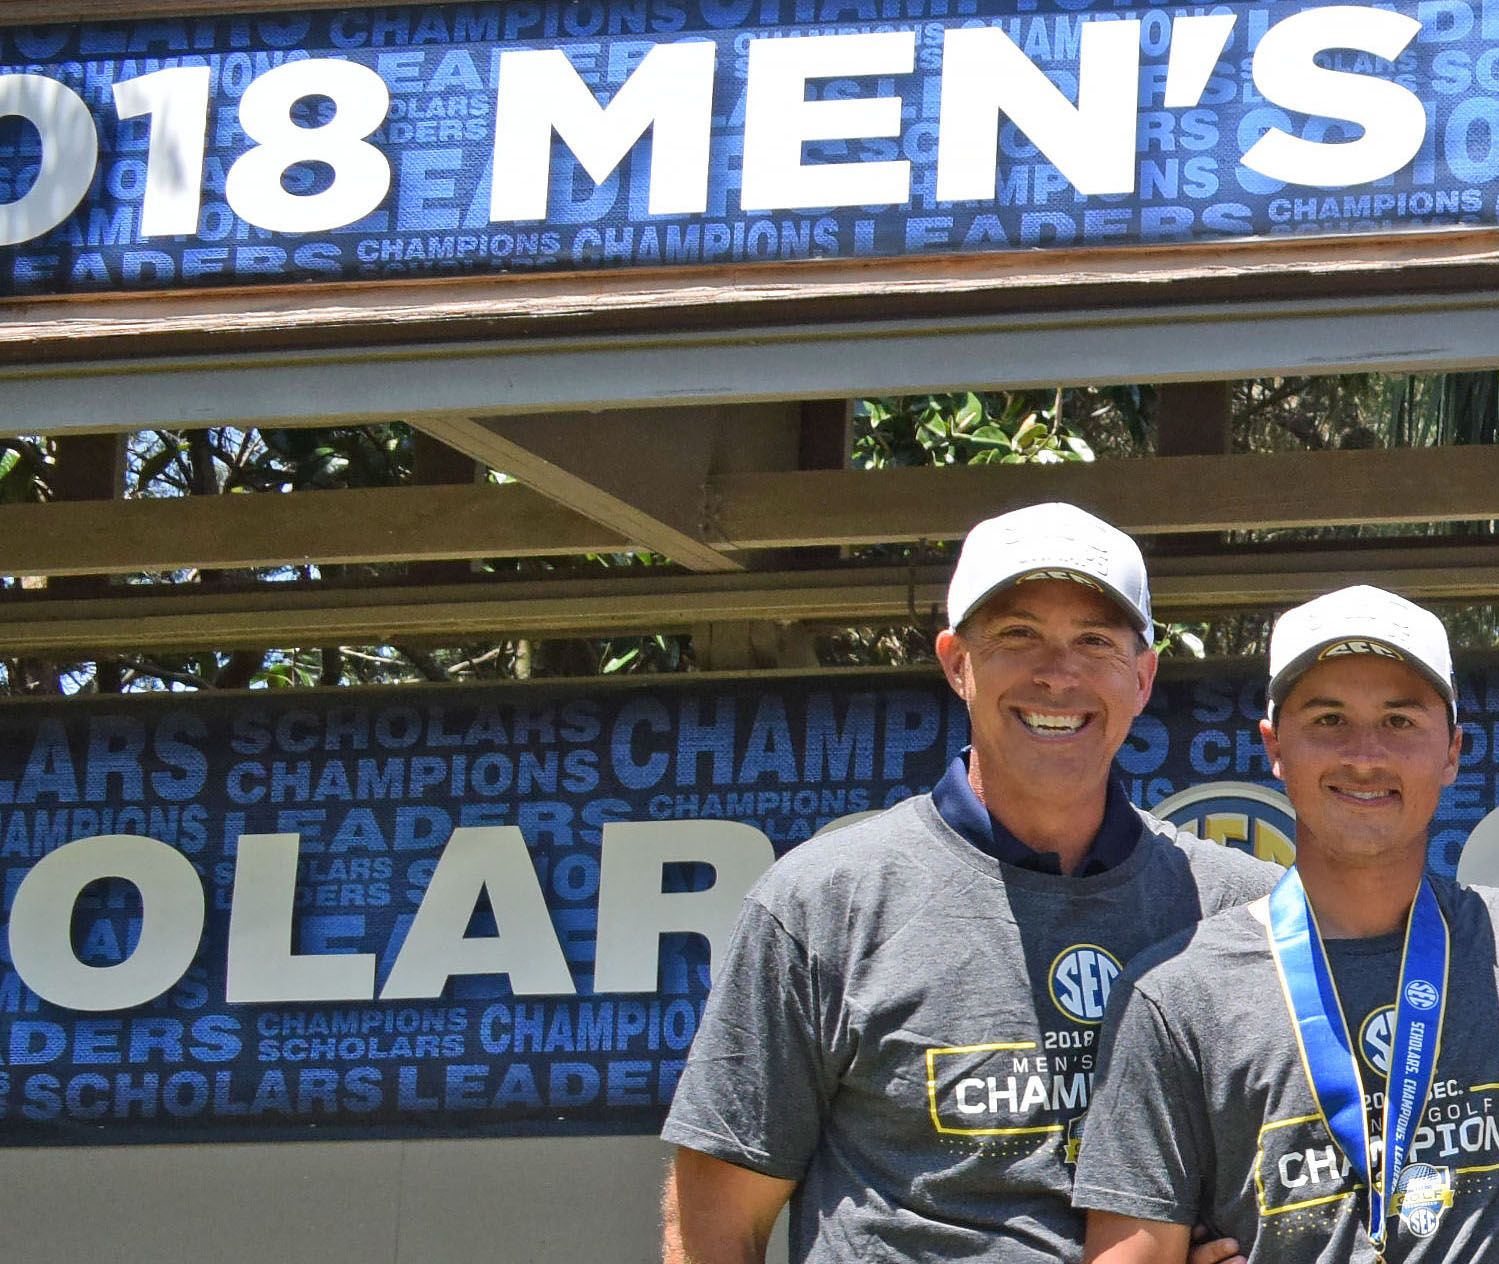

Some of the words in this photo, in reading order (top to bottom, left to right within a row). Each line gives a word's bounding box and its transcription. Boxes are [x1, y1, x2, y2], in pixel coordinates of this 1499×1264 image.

[490, 3, 1426, 222] MEN'S
[356, 231, 562, 262] CHAMPIONS
[570, 218, 840, 263] CHAMPIONS
[1267, 189, 1483, 224] CHAMPIONS
[231, 698, 602, 755] SCHOLARS
[226, 749, 602, 803] CHAMPIONS
[648, 787, 869, 818] CHAMPIONS
[9, 810, 880, 1012] OLAR
[1407, 981, 1438, 1009] SEC
[0, 1012, 243, 1066] DERS
[257, 1003, 468, 1037] CHAMPIONS
[480, 998, 698, 1055] CHAMPIO
[258, 1033, 466, 1063] SCHOLARS
[1044, 1030, 1095, 1050] 2018
[1405, 1021, 1425, 1075] SCHOLARS.
[23, 1066, 384, 1122] SCHOLARS
[398, 1058, 688, 1114] LEADE
[1012, 1053, 1094, 1074] MEN'S
[1428, 1079, 1464, 1101] EC.
[1395, 1079, 1417, 1142] CHAMPIONS.
[1428, 1097, 1493, 1122] GOLF
